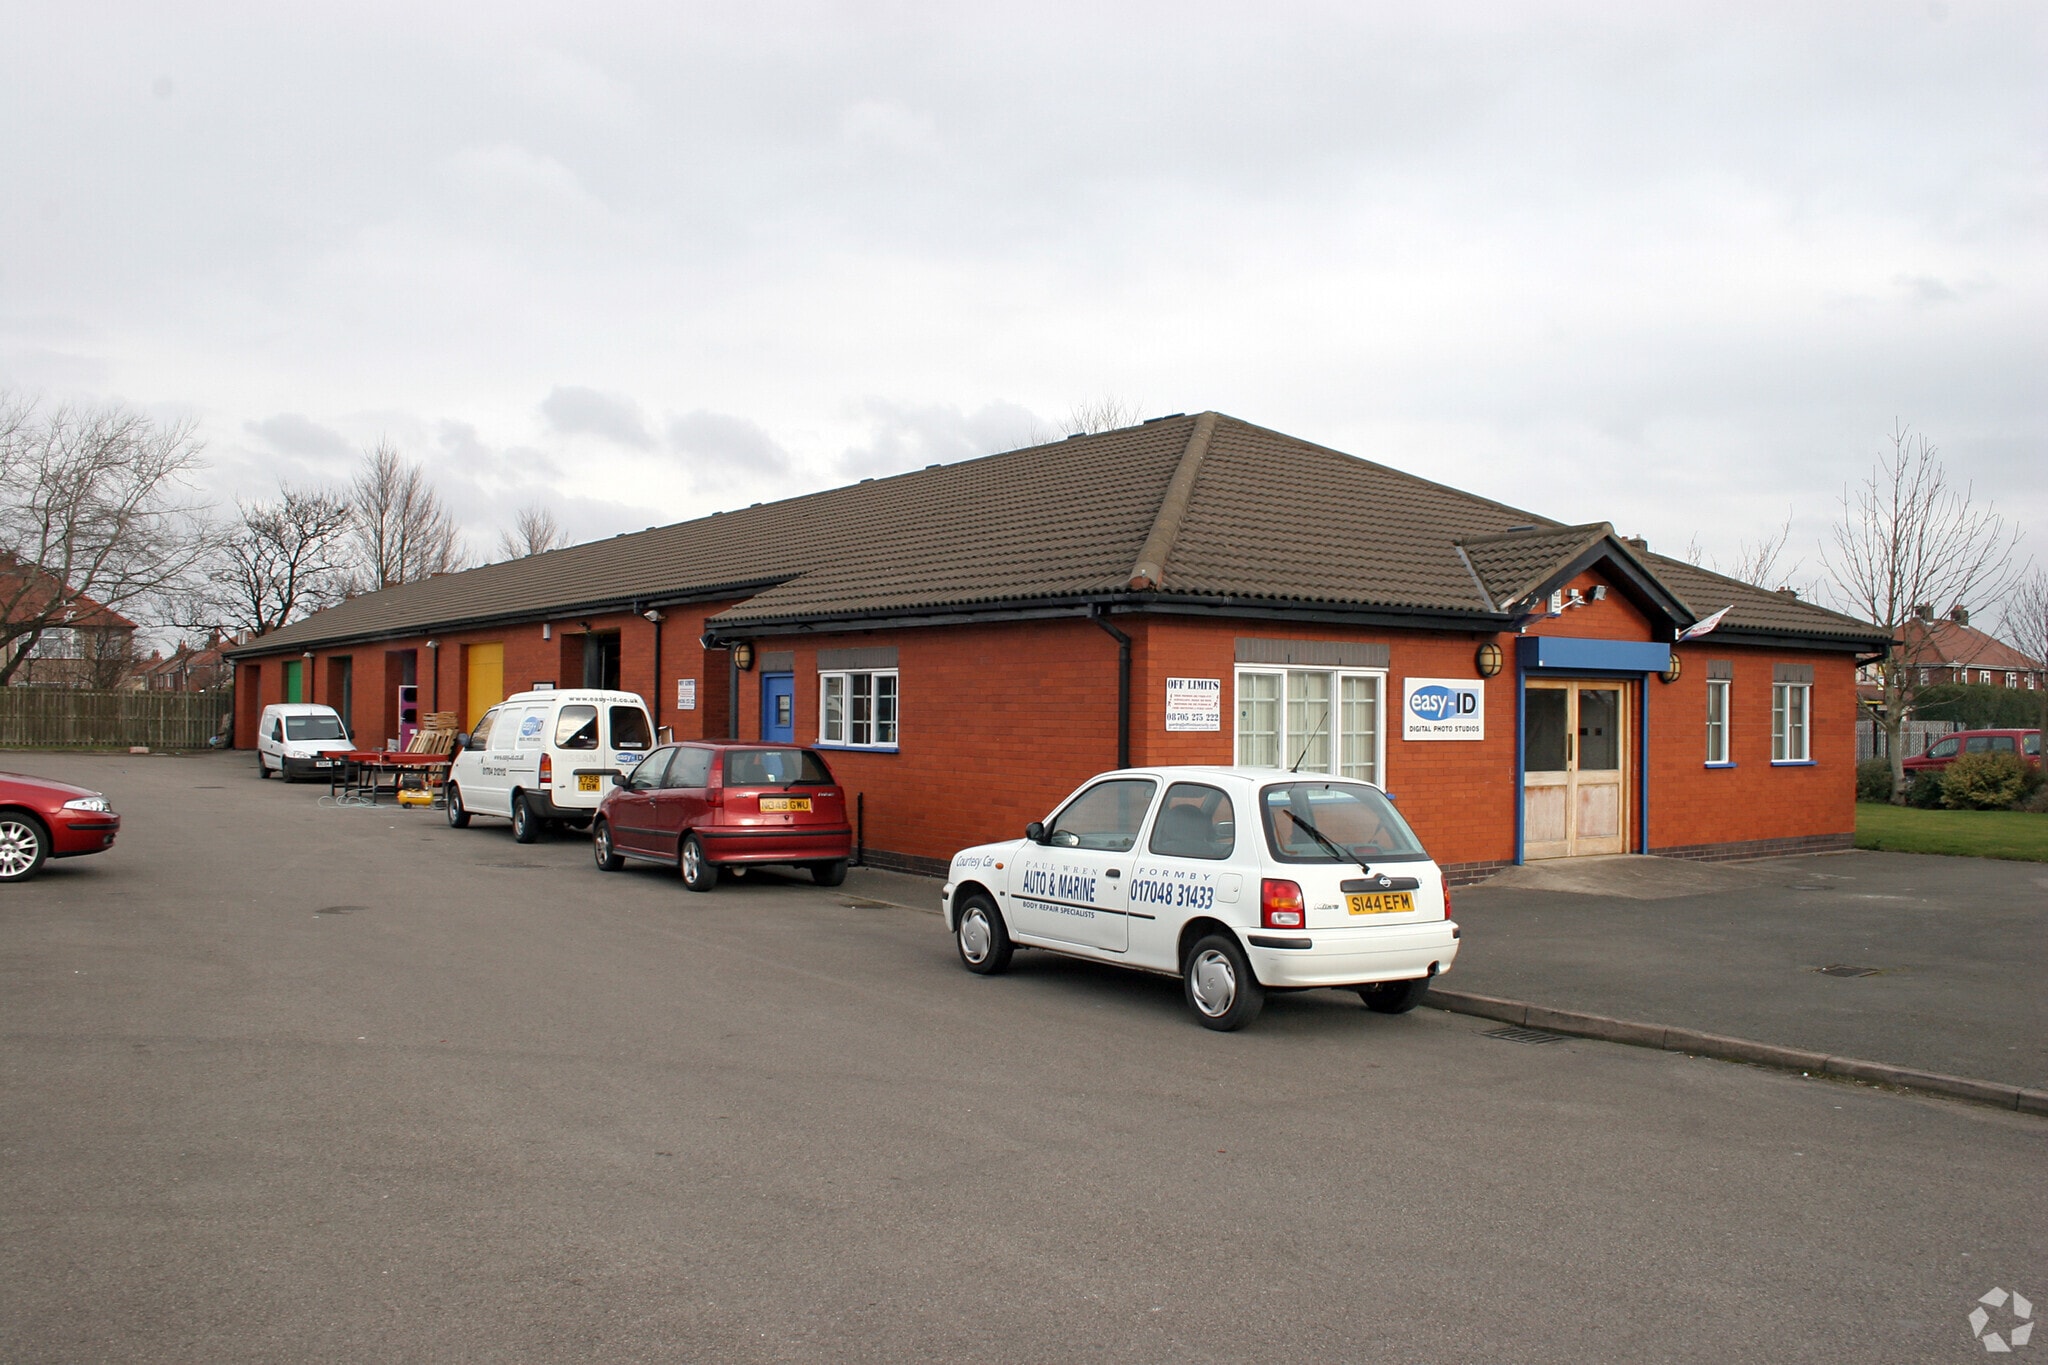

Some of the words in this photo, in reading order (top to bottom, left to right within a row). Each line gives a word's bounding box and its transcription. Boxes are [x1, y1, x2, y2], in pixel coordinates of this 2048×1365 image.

[1167, 679, 1185, 689] OFF
[1187, 680, 1219, 690] LIMITS
[568, 696, 638, 704] www.easy-id.co.uk
[1411, 693, 1476, 718] easy-ID
[1167, 712, 1189, 721] 08705
[616, 752, 643, 762] easy-ID
[581, 783, 597, 791] TBW
[761, 801, 788, 810] N348
[789, 801, 809, 809] GWU
[956, 855, 983, 870] Courtesy
[982, 855, 995, 867] Car
[1025, 861, 1056, 871] PAUL
[1063, 865, 1099, 876] WREN
[1139, 868, 1211, 881] FORMBY
[1023, 870, 1047, 895] AUTO
[1049, 872, 1056, 897] &
[1058, 874, 1096, 903] MARINE
[1130, 879, 1173, 905] 017048
[1176, 884, 1214, 910] 31433
[1022, 901, 1038, 909] BODY
[1039, 903, 1059, 913] REPAIR
[1060, 907, 1095, 919] SPECIALISTS
[1351, 896, 1382, 912] S144
[1383, 894, 1411, 910] EFM
